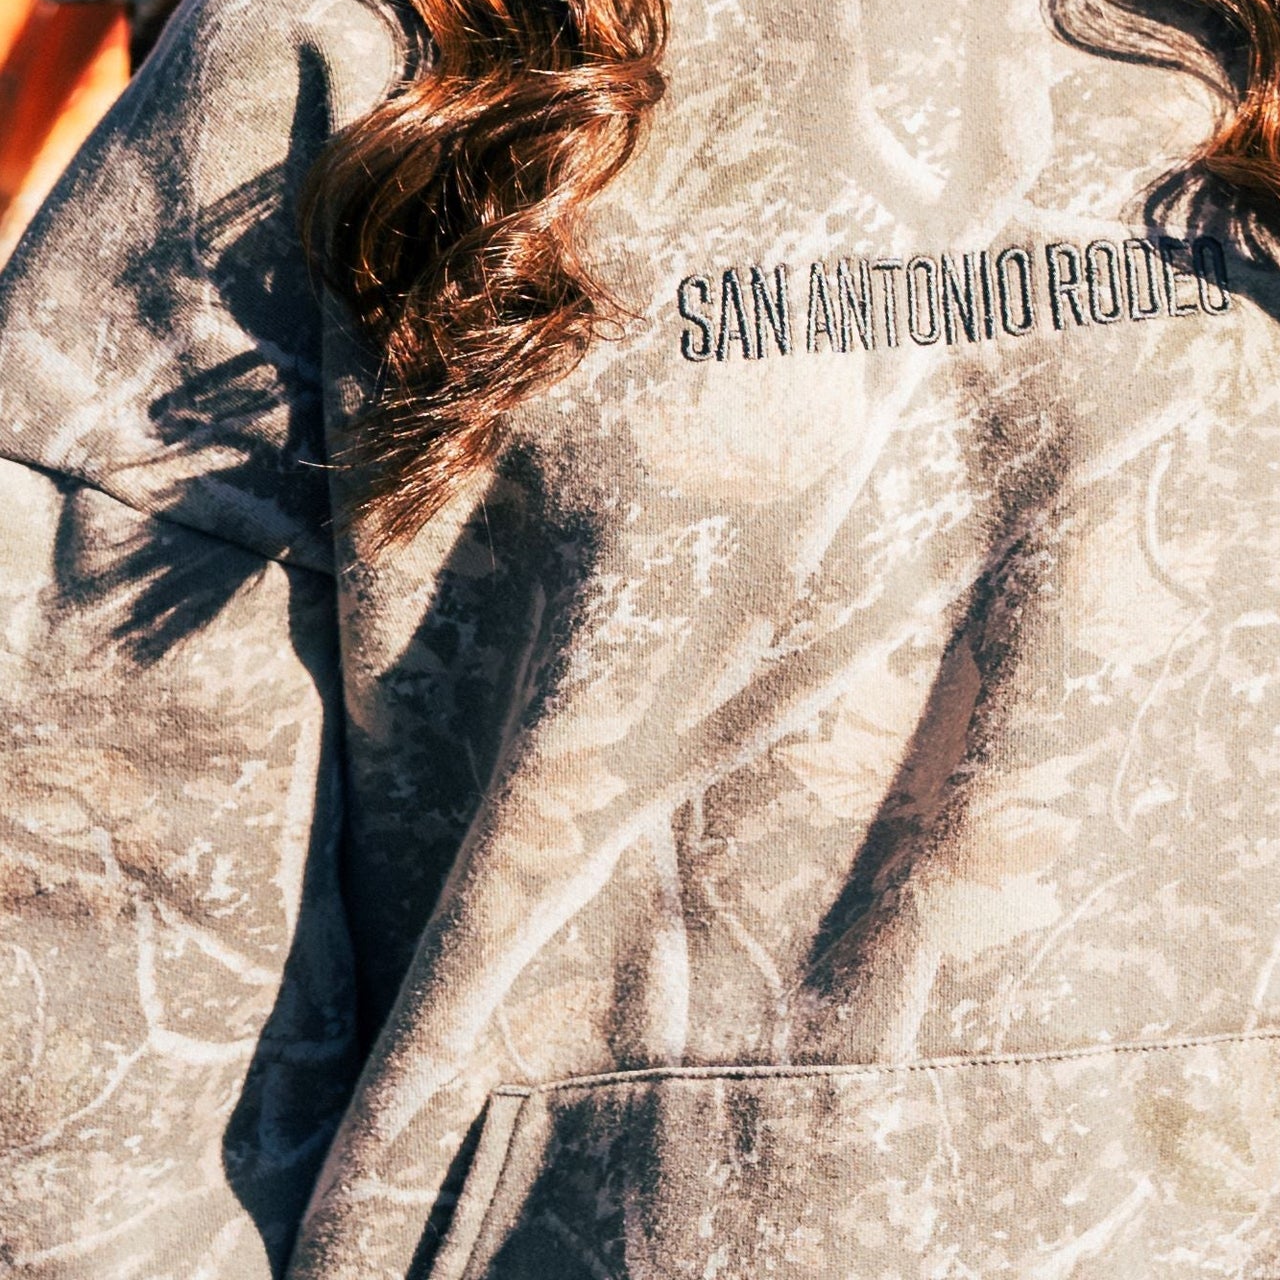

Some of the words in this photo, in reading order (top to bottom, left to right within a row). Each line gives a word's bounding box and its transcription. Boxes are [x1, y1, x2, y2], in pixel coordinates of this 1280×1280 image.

[677, 264, 793, 362] SAN
[805, 246, 1036, 354] ANTONIO
[1045, 235, 1232, 333] RODEO
